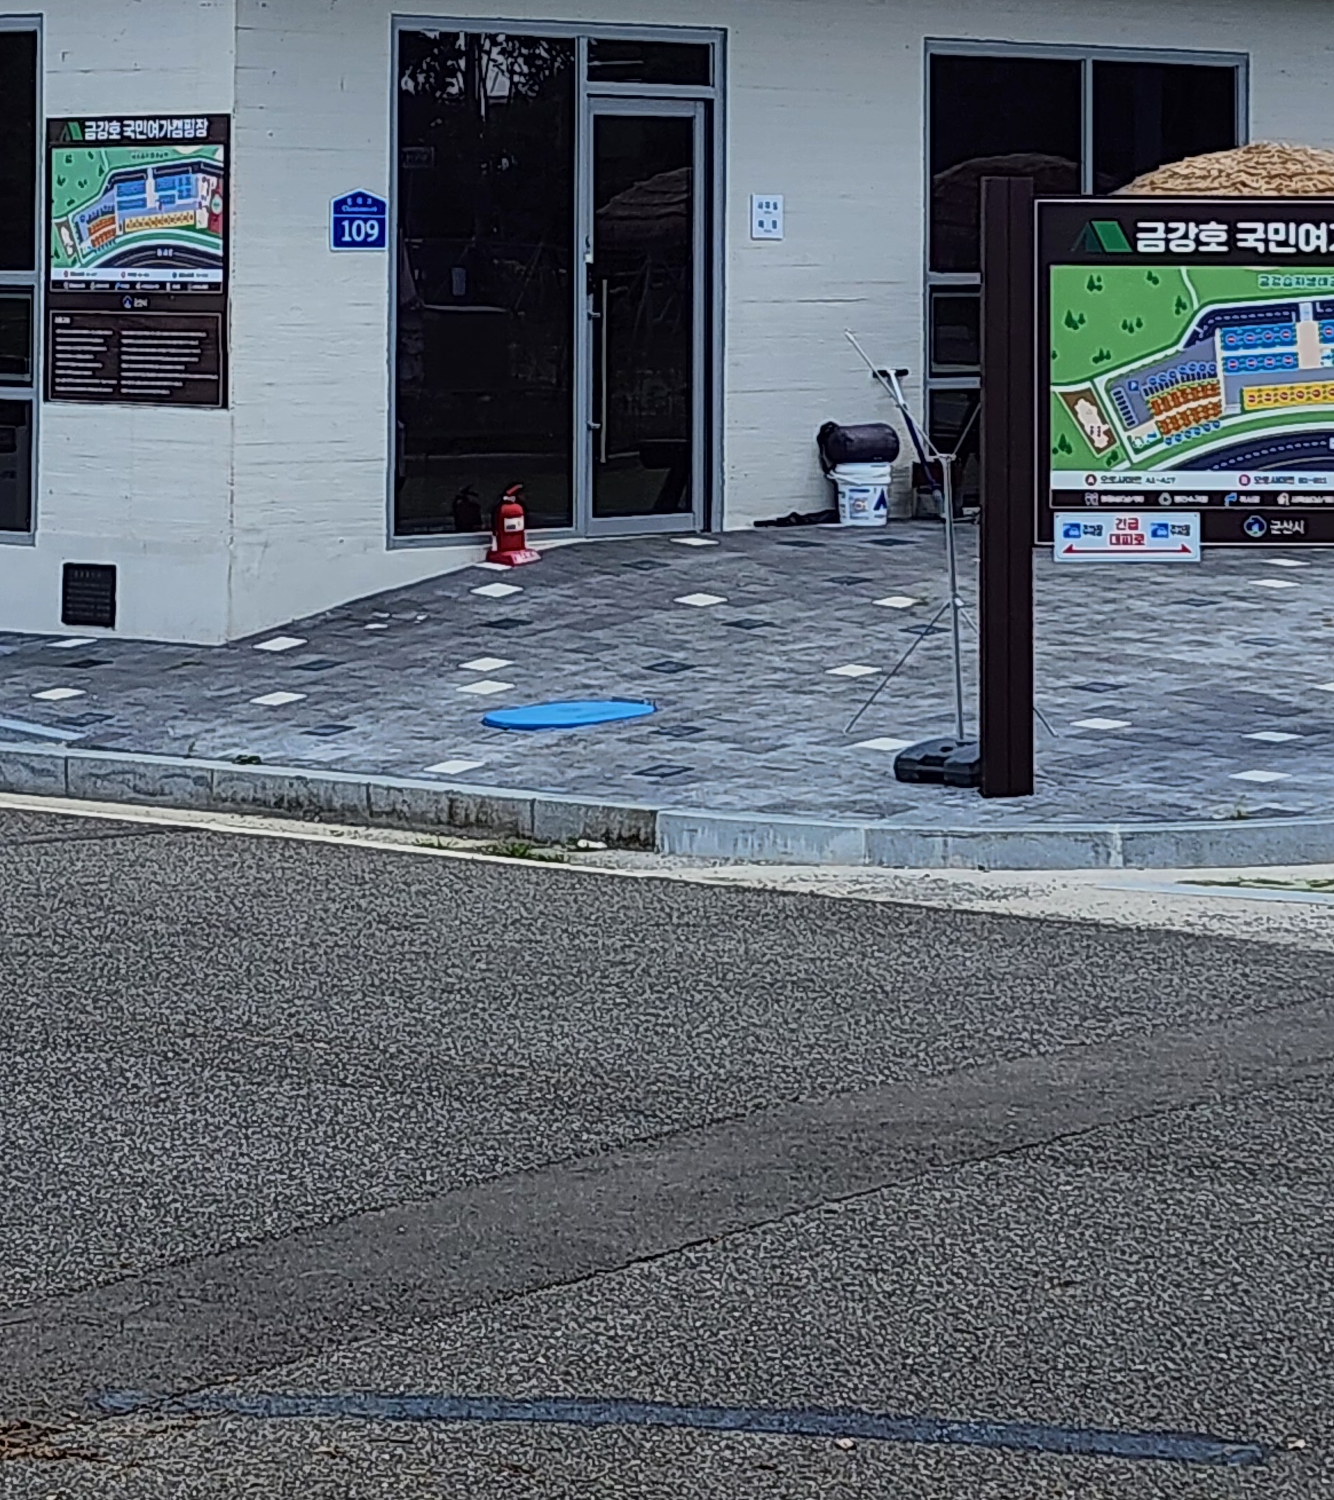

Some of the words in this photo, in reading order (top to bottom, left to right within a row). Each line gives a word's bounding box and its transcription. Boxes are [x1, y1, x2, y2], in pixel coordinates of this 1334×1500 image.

[341, 219, 379, 242] 109
[1136, 221, 1229, 253] 금강호
[1116, 518, 1139, 531] 긴급
[1270, 520, 1305, 534] 군산시
[1109, 533, 1146, 546] 대피로
